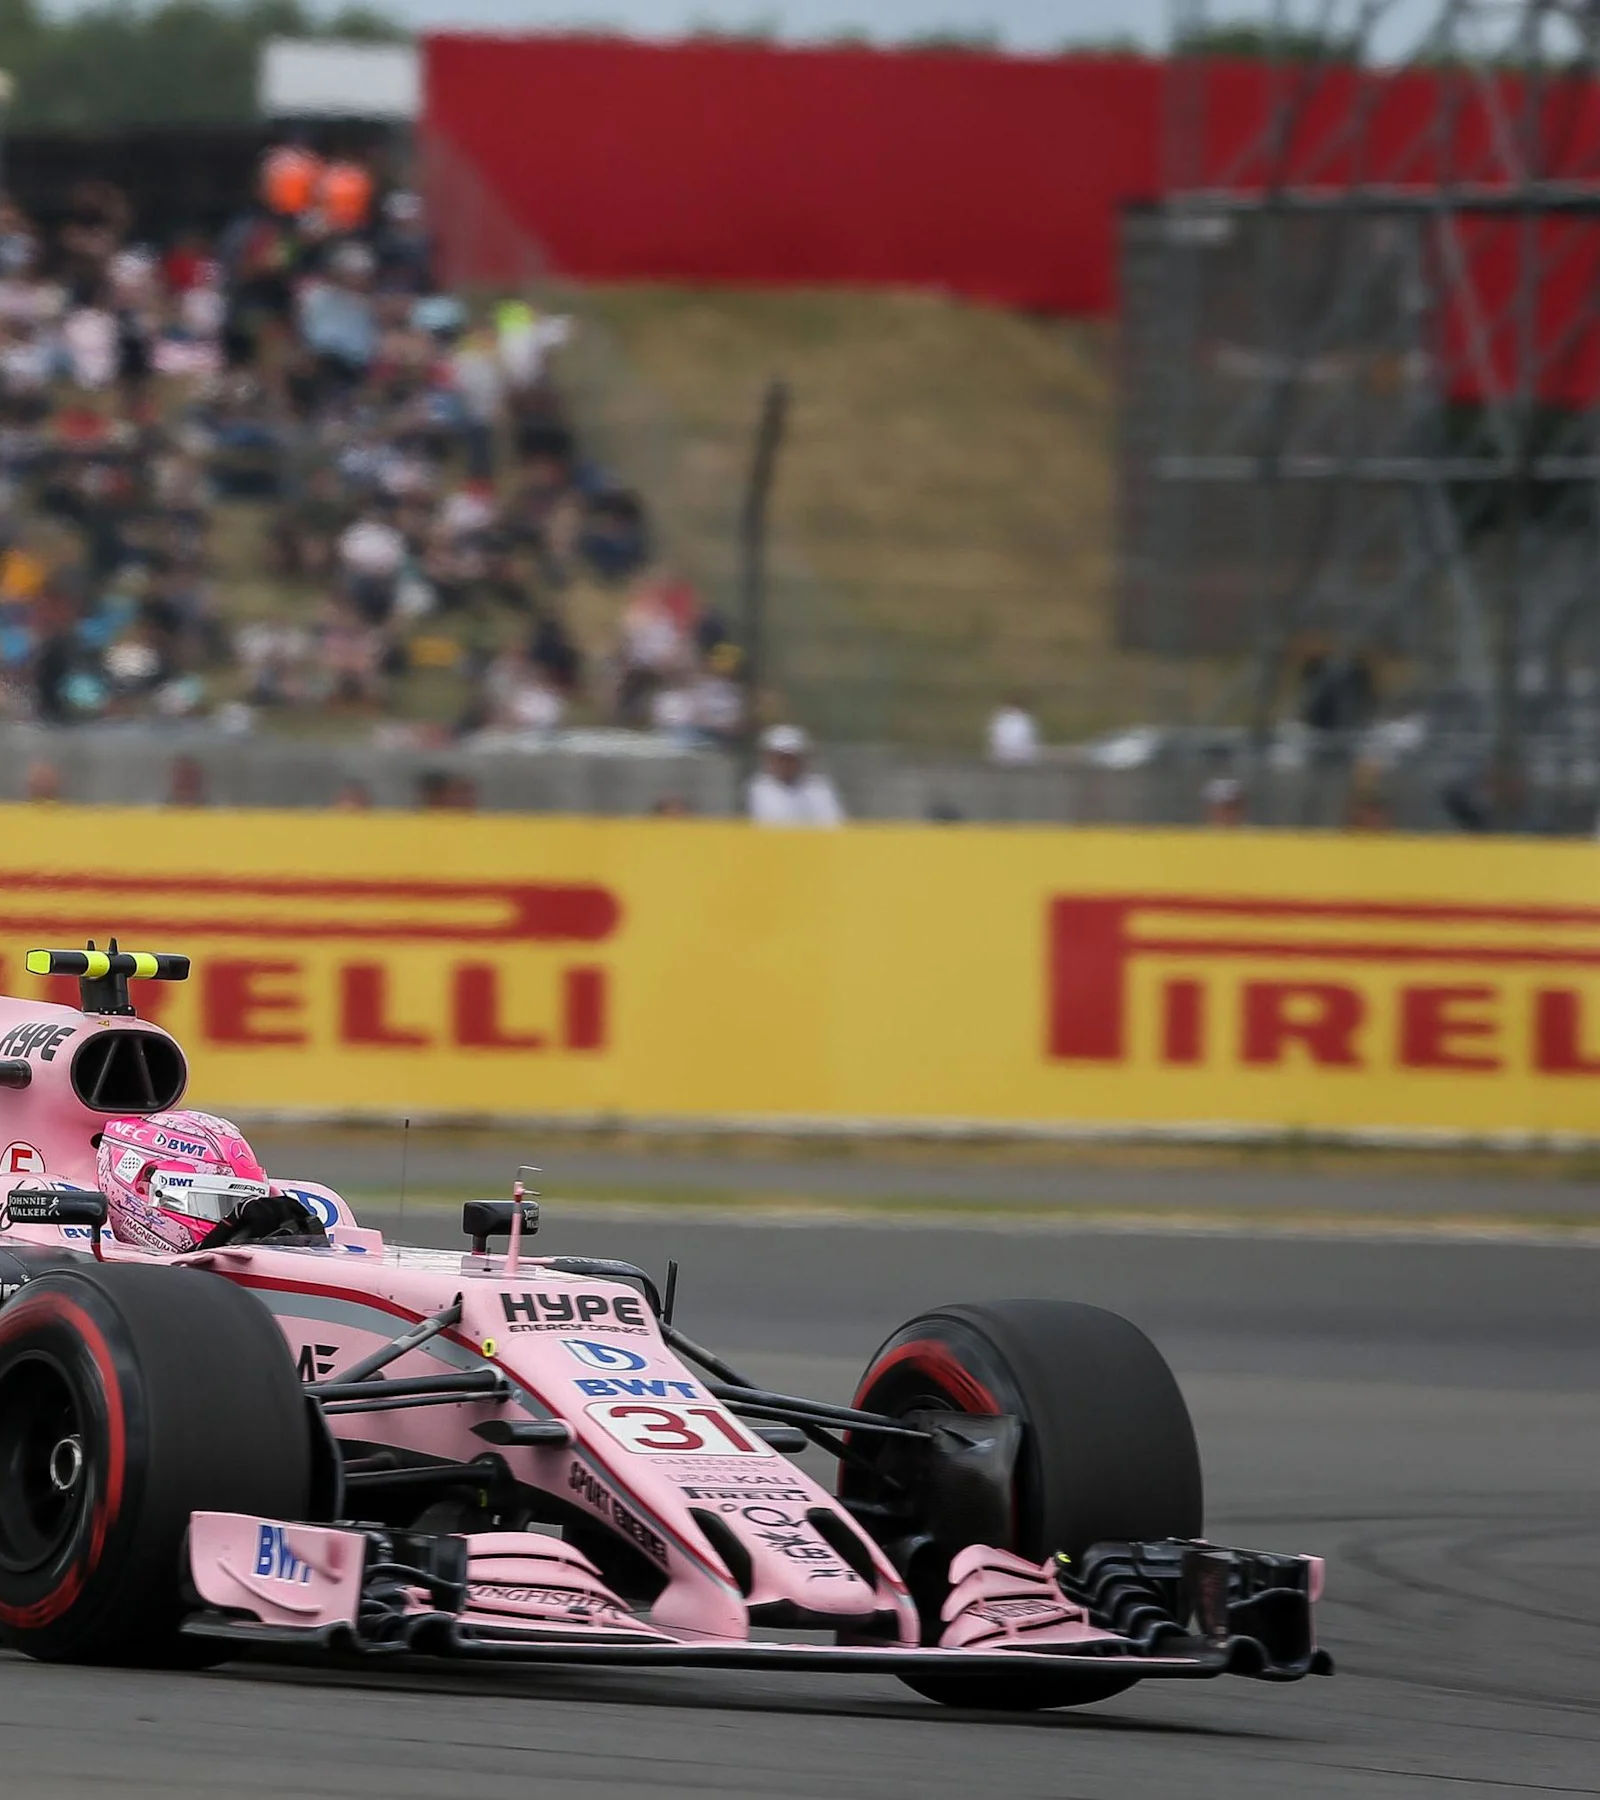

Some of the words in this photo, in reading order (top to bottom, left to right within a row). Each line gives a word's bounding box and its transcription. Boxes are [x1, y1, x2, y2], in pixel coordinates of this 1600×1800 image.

[111, 1121, 149, 1142] NEC
[167, 1139, 207, 1157] BWT
[169, 1177, 194, 1188] BWT
[8, 1195, 47, 1207] JOHNNIE
[10, 1207, 47, 1217] WALKER
[125, 1217, 170, 1252] MAGNESIUM
[500, 1293, 646, 1326] HYPE
[509, 1324, 582, 1332] ENERGY
[586, 1325, 650, 1336] DRINKS
[574, 1378, 700, 1399] BWT
[610, 1406, 758, 1452] 31
[664, 1474, 799, 1485] URALKALI
[680, 1486, 813, 1502] PIRELLI
[257, 1524, 312, 1583] BW
